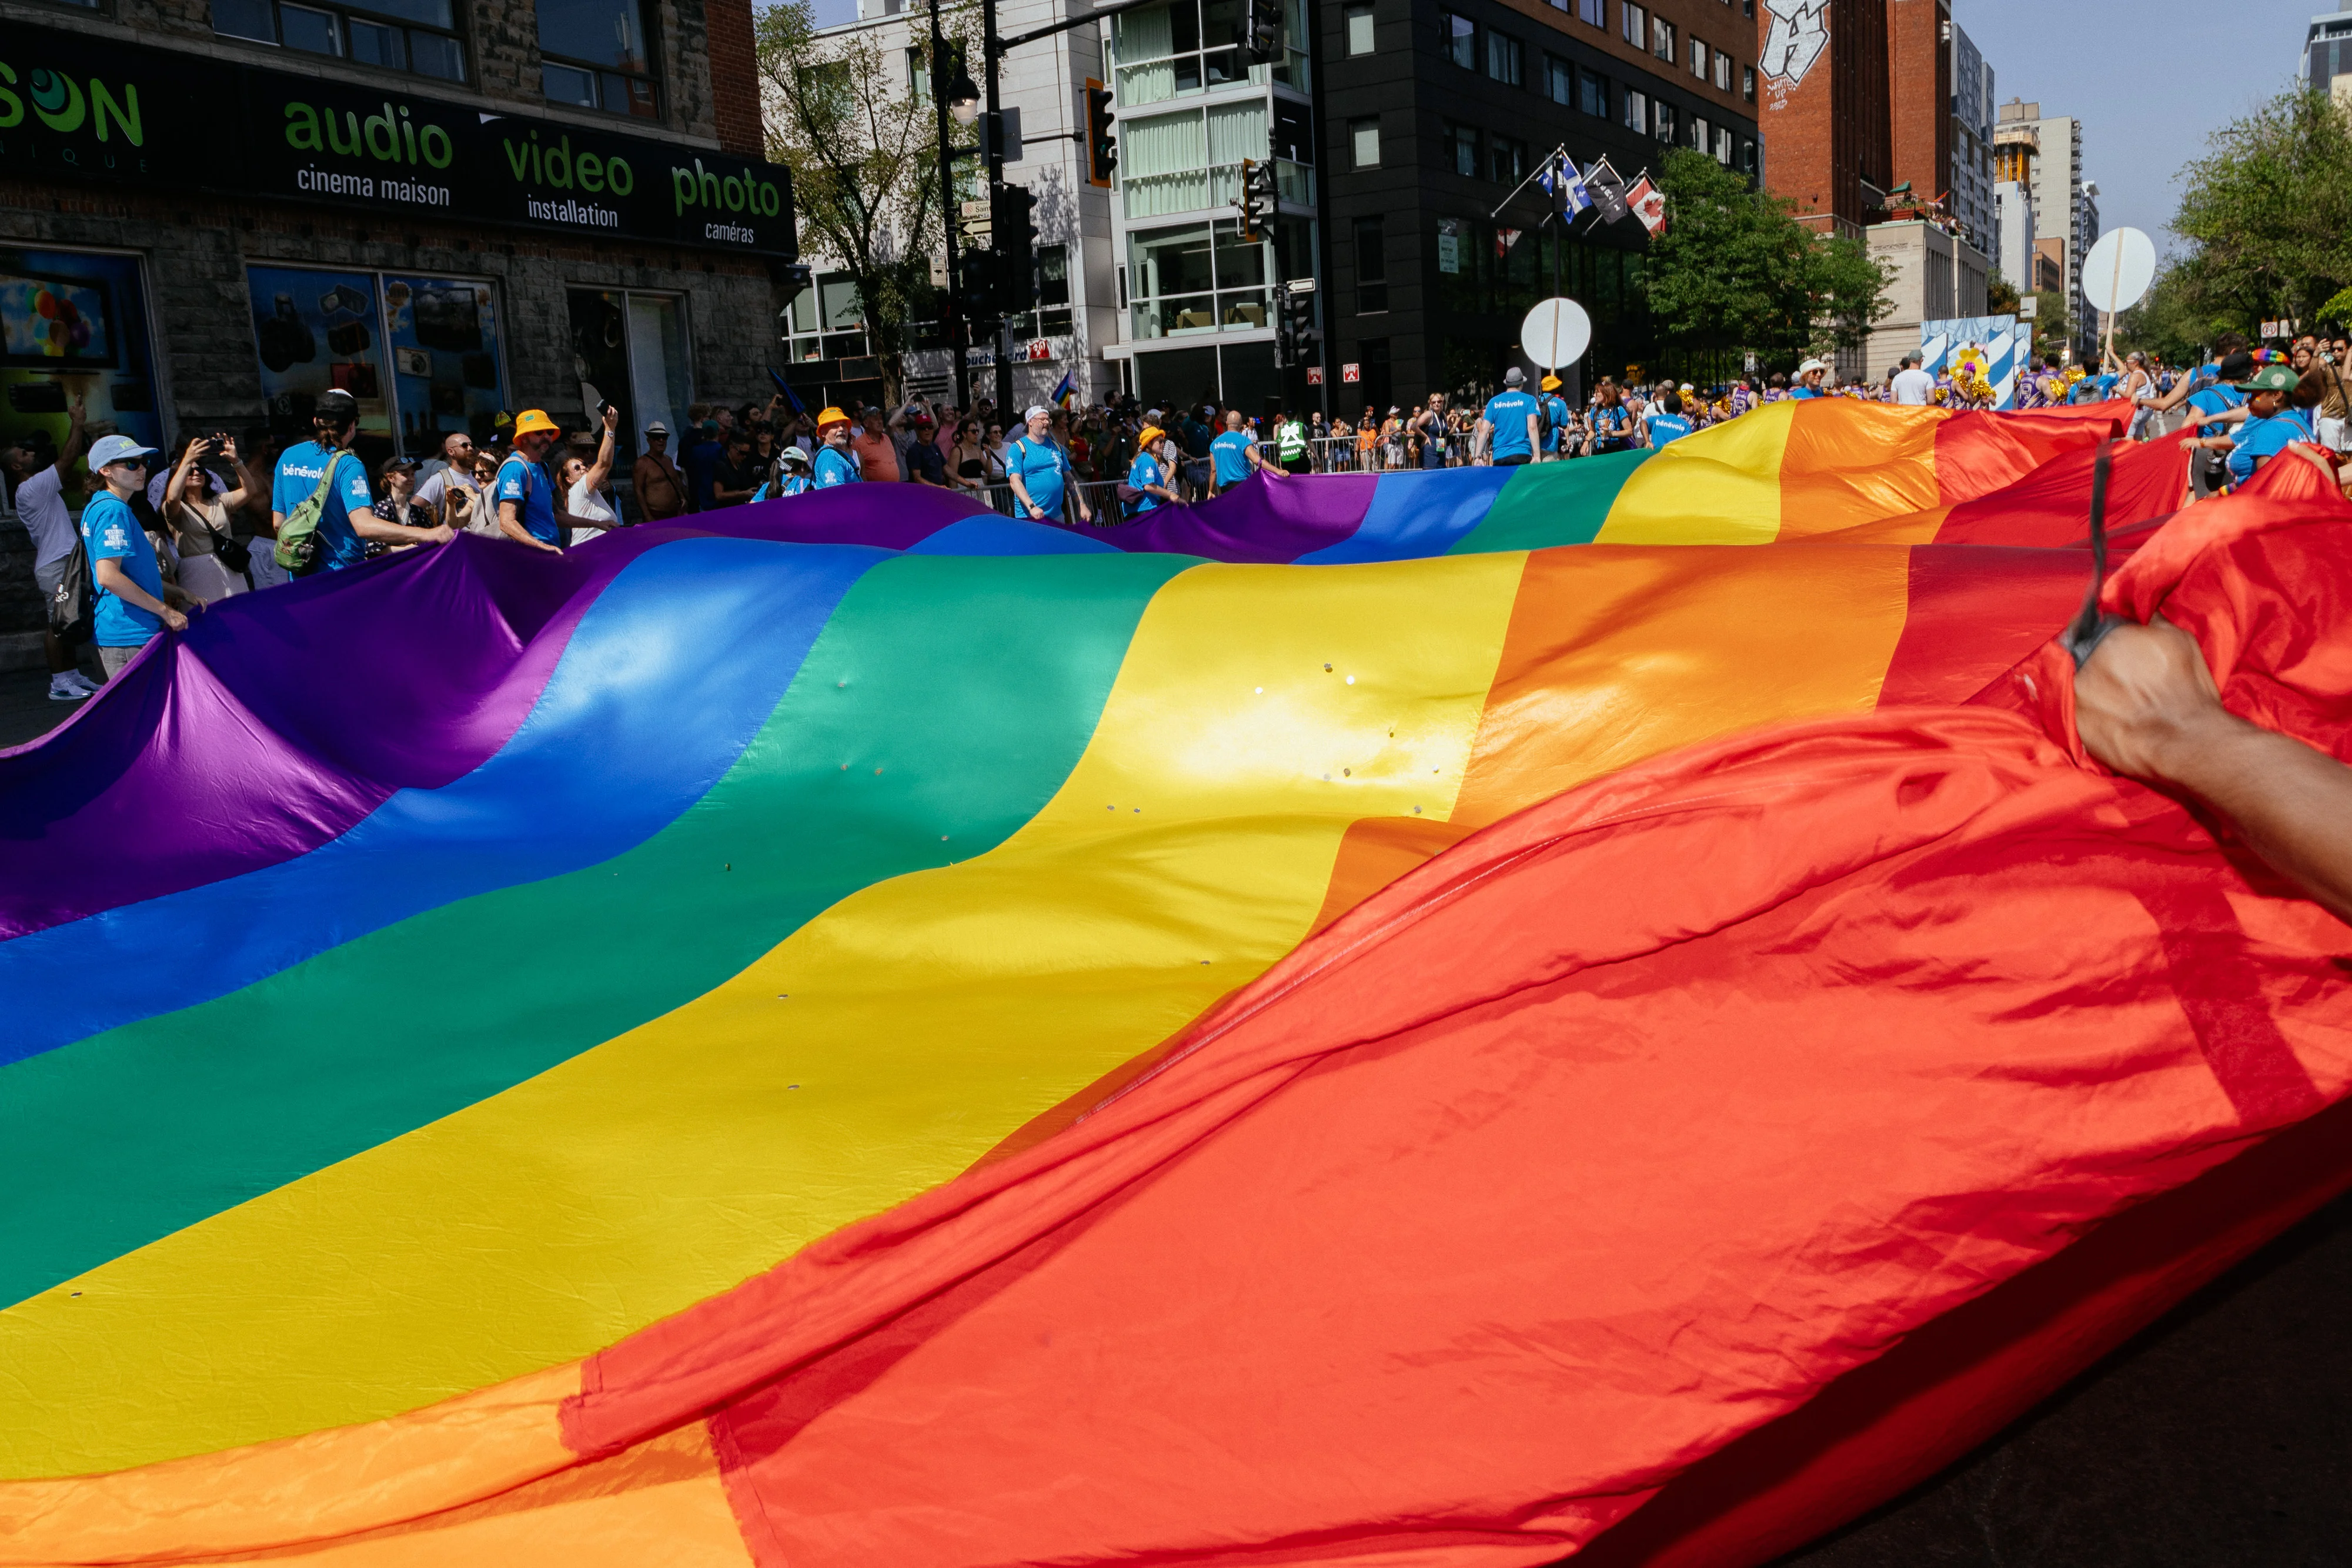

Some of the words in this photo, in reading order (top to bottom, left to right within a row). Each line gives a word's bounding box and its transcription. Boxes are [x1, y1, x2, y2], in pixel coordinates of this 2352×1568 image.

[1775, 89, 1786, 99] UP
[285, 101, 453, 170] audio
[503, 129, 634, 196] video
[298, 163, 373, 198] cinema
[381, 177, 450, 206] maison
[671, 158, 780, 217] photo
[528, 194, 618, 228] installation
[706, 221, 754, 244] caméras
[965, 349, 1028, 365] oucherd
[1494, 400, 1524, 409] bénévole
[1655, 419, 1685, 432] bénévole
[1214, 442, 1237, 450] bénévole
